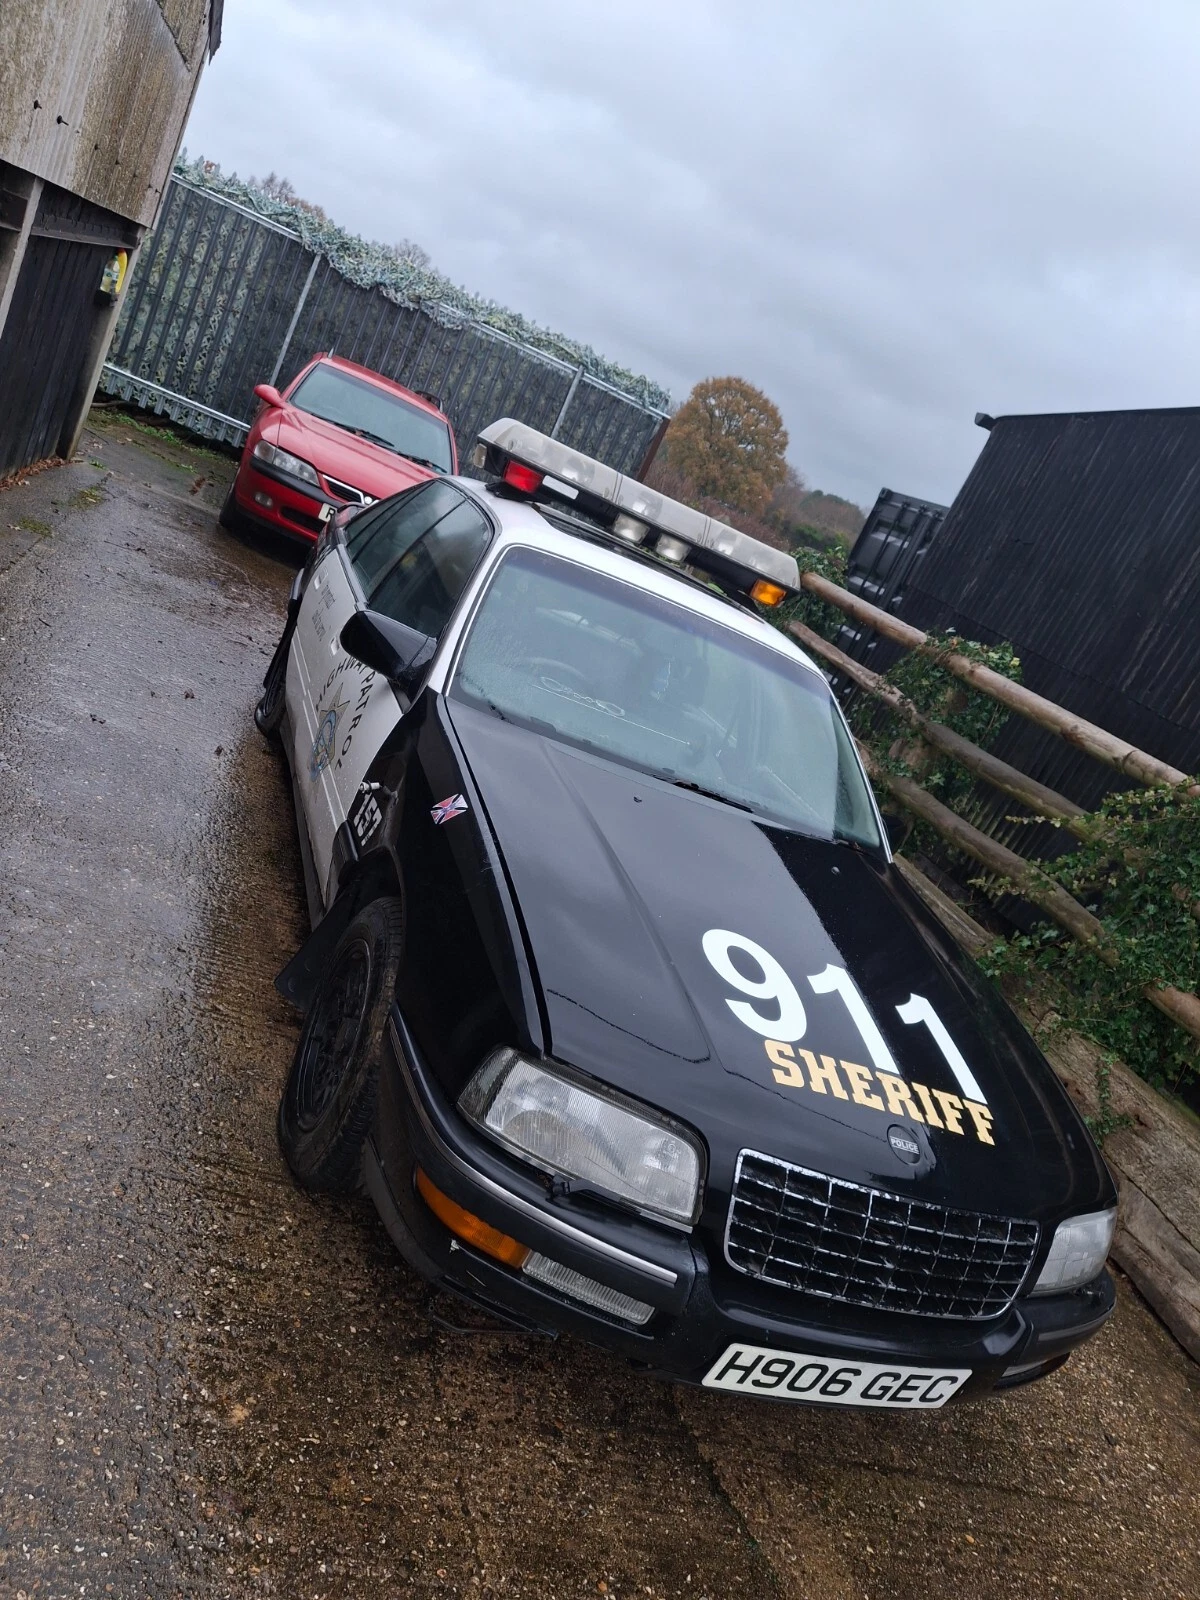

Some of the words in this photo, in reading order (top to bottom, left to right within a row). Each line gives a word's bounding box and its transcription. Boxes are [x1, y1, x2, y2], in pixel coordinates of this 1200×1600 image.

[334, 670, 377, 771] PATROL
[702, 928, 989, 1105] 911
[764, 1039, 996, 1146] SHERIFF
[890, 1137, 920, 1154] POLICE
[714, 1351, 862, 1397] H906
[860, 1371, 959, 1403] GEC
